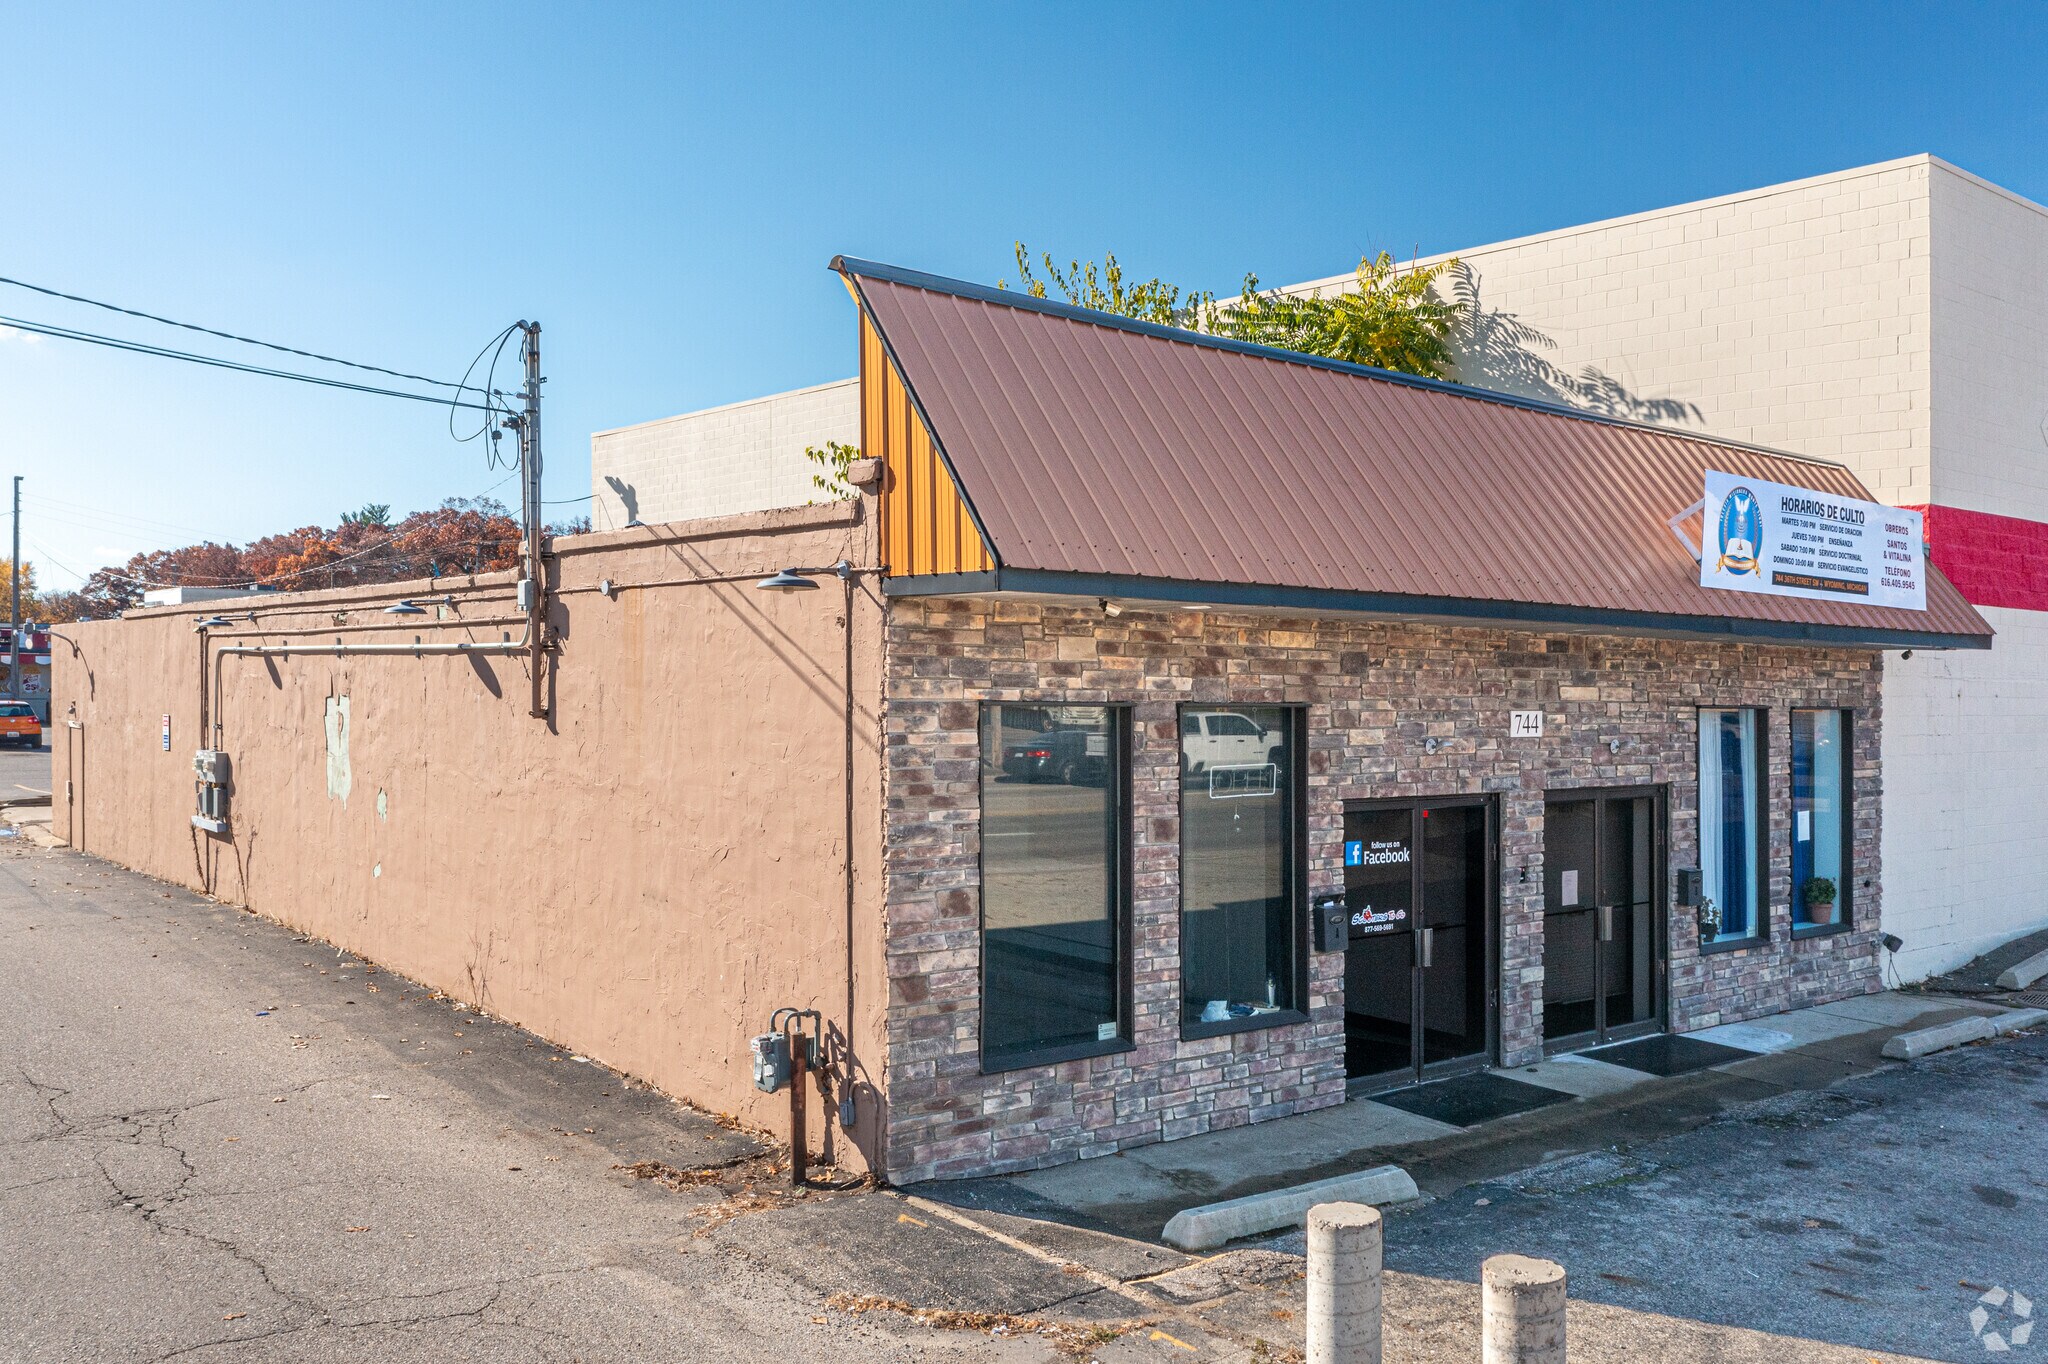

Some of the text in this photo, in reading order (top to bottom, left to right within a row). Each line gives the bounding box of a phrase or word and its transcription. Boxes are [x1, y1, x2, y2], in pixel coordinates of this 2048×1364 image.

[1781, 496, 1825, 518] HORARIOS
[1827, 504, 1838, 519] DE
[1840, 507, 1865, 524] CULTO
[1781, 517, 1799, 527] MARTES
[1800, 519, 1808, 528] 7:00
[1809, 521, 1816, 529] PM
[1819, 523, 1838, 533] SERVICIO
[1838, 526, 1844, 534] DE
[1885, 523, 1909, 535] OBREROS
[1791, 531, 1808, 541] JUEVES
[1808, 534, 1817, 542] 7:00
[1817, 535, 1824, 543] PM
[1887, 539, 1908, 551] SANTOS
[1799, 546, 1808, 554] 7:00
[1808, 547, 1815, 555] PM
[1819, 548, 1838, 558] SERVICIO
[1883, 550, 1912, 562] & VITALINA
[1773, 555, 1794, 565] DOMINGO
[1795, 558, 1807, 567] 10:00
[1807, 560, 1814, 568] AM
[1817, 562, 1837, 571] SERVICIO
[1885, 565, 1911, 578] TELÉFONO
[1880, 577, 1915, 590] 616.405.9545
[1515, 714, 1539, 734] 744
[1371, 841, 1386, 849] follow
[1363, 847, 1410, 865] Facebook
